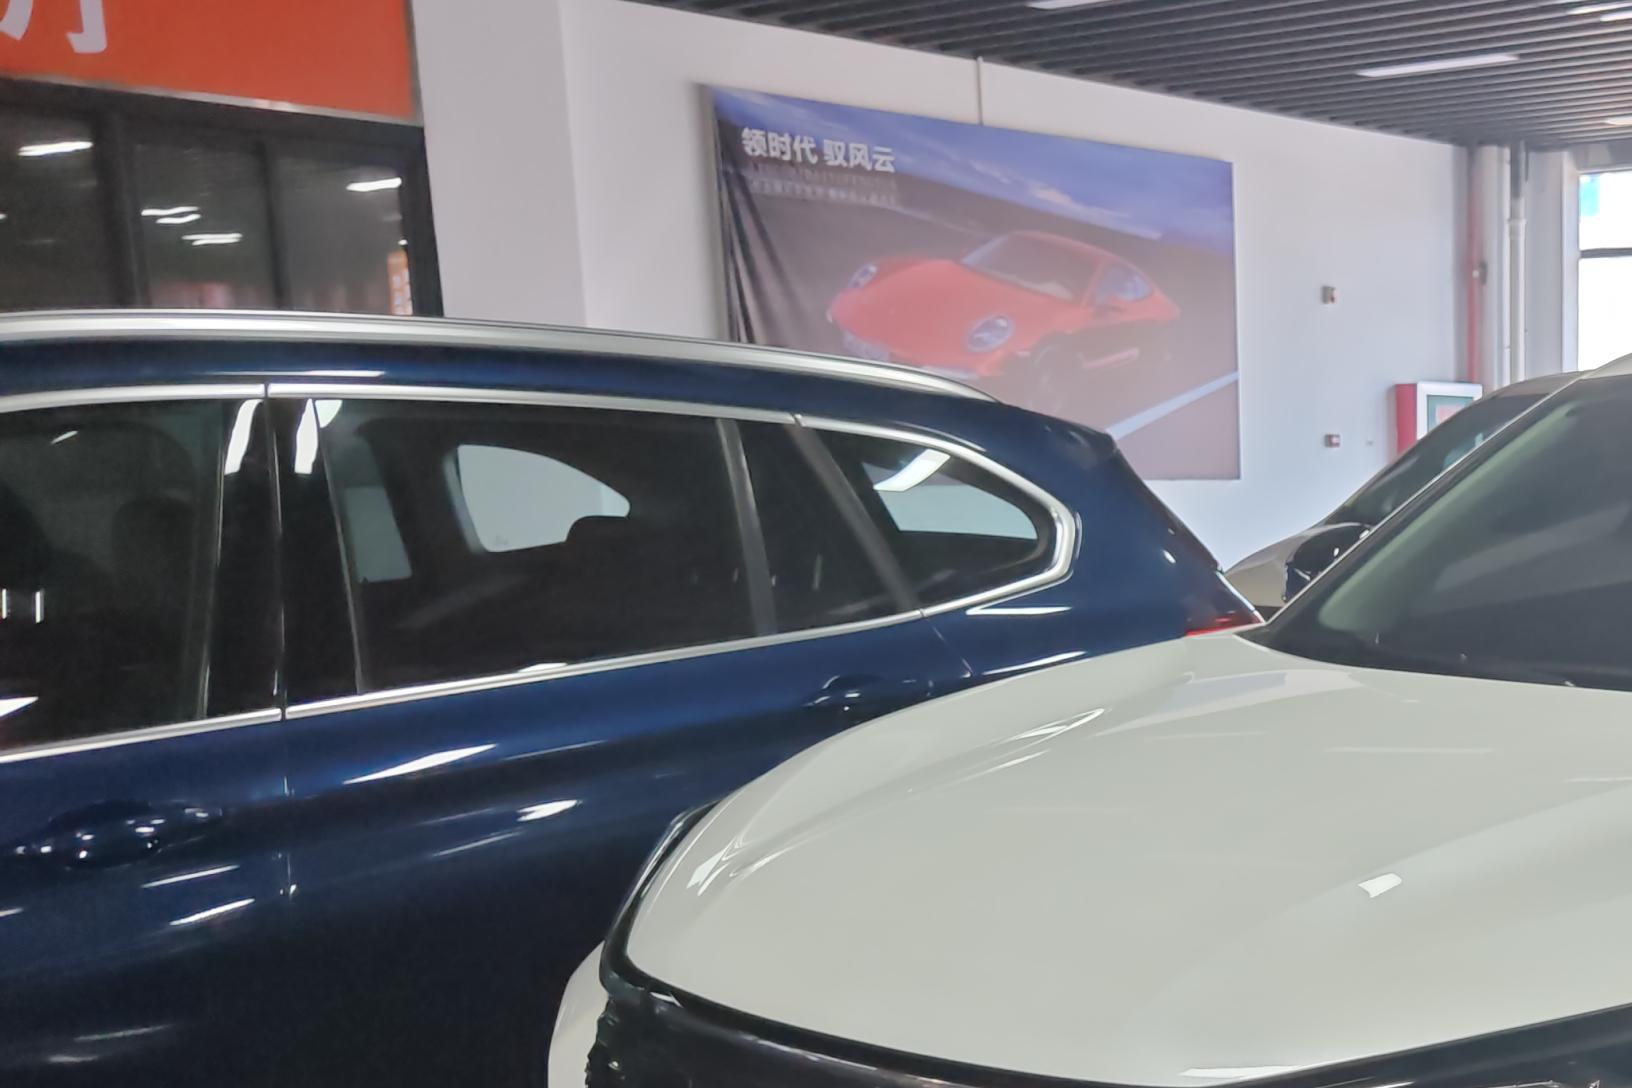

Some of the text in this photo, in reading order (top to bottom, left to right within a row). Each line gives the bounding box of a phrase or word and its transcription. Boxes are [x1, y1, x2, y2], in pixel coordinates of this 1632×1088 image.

[741, 127, 896, 173] 领时代 驭风云
